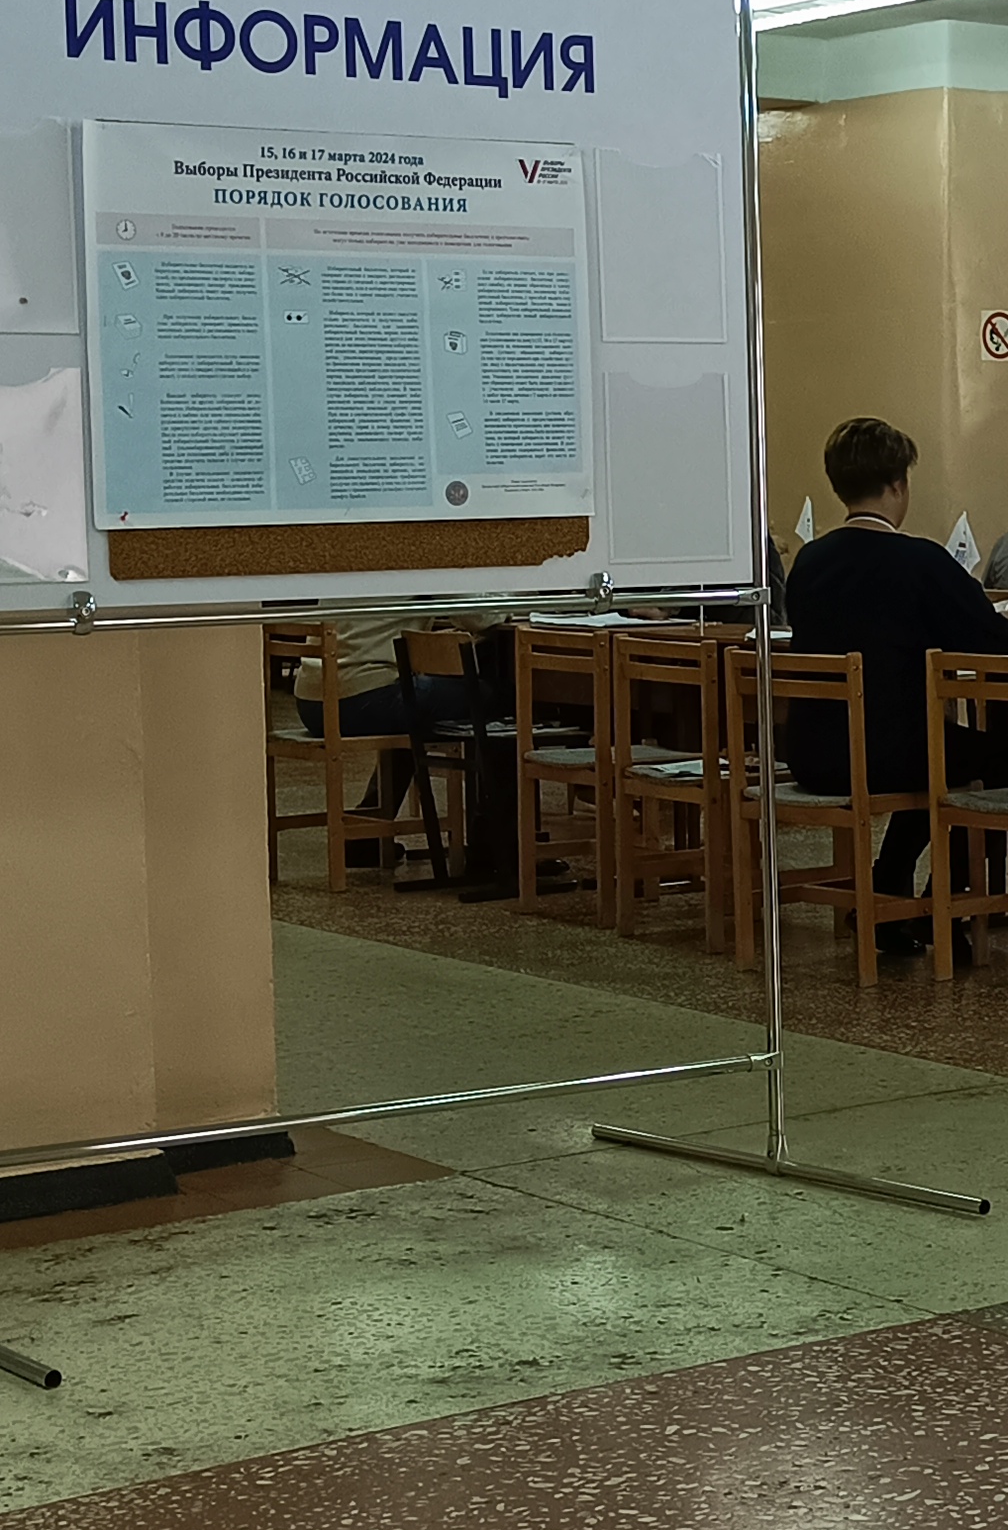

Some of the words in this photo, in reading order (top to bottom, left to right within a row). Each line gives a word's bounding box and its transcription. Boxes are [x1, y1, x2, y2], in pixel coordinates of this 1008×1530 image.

[260, 146, 278, 160] 15,
[282, 147, 296, 159] 16
[298, 150, 307, 160] и
[311, 149, 325, 161] 17
[327, 152, 365, 166] марта
[368, 151, 395, 164] 2024
[398, 155, 424, 167] года
[173, 161, 239, 180] Выборы
[242, 164, 333, 183] Президента
[336, 168, 420, 186] Российской
[423, 172, 502, 190] Федерации
[214, 189, 312, 208] ПОРЯДОК
[319, 193, 468, 212] ГОЛОСОВАНИЯ
